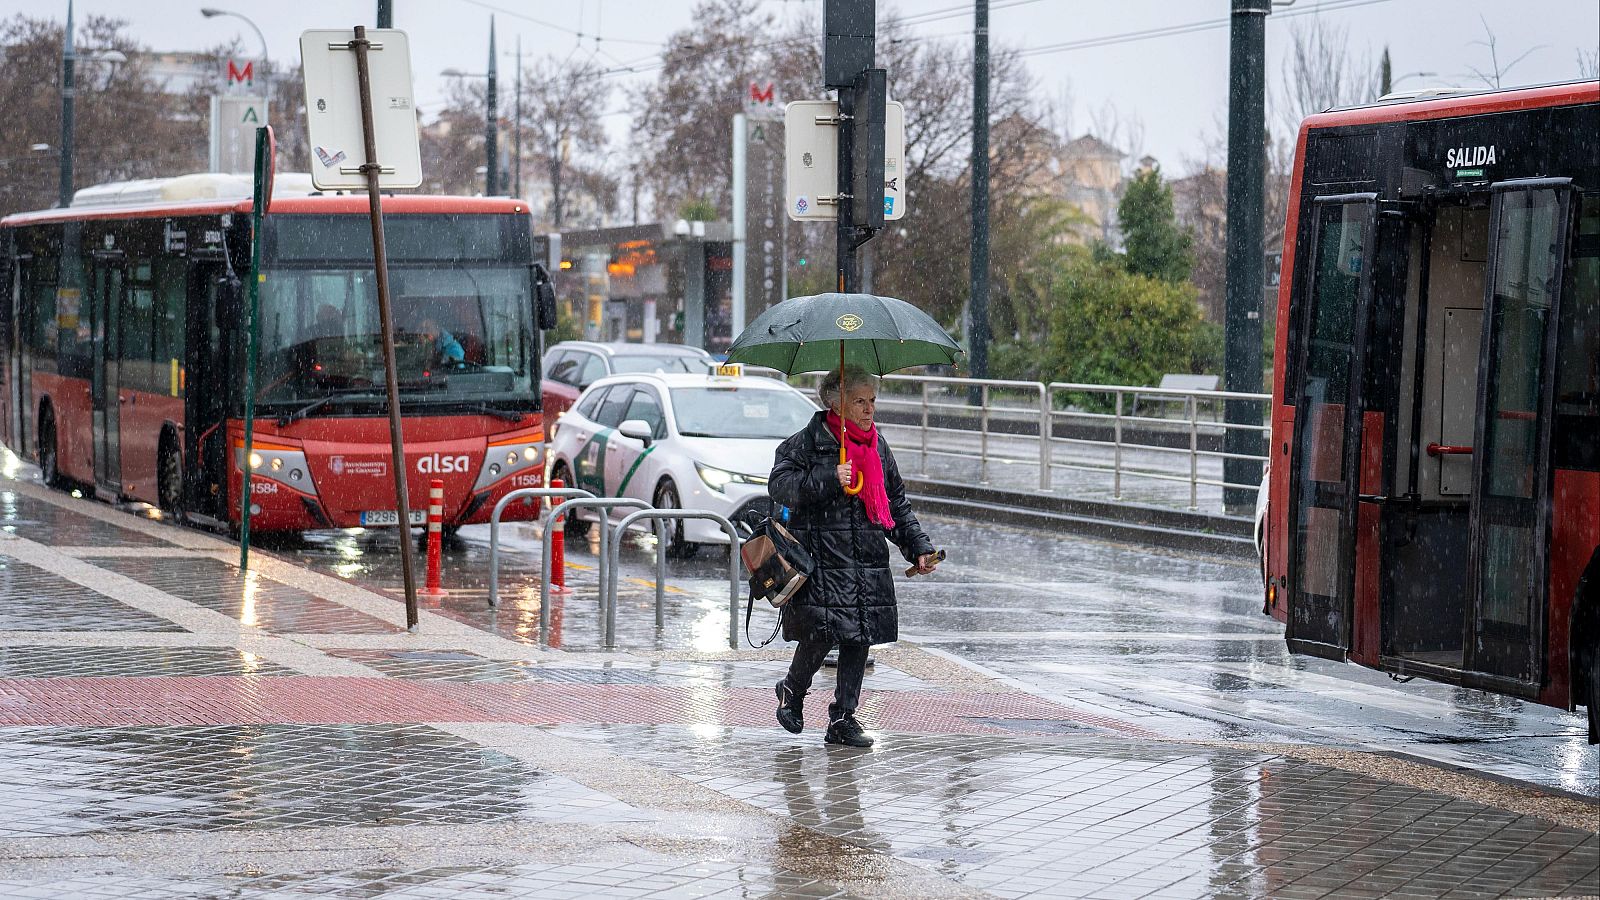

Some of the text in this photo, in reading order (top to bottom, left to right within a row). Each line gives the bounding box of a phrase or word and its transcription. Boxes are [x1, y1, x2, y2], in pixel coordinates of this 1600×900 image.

[228, 60, 253, 86] M
[750, 82, 774, 106] M
[1446, 145, 1496, 168] SALIDA
[417, 453, 469, 473] alsa
[250, 482, 278, 494] 1584
[511, 474, 541, 486] 11584
[367, 511, 397, 523] 8296
